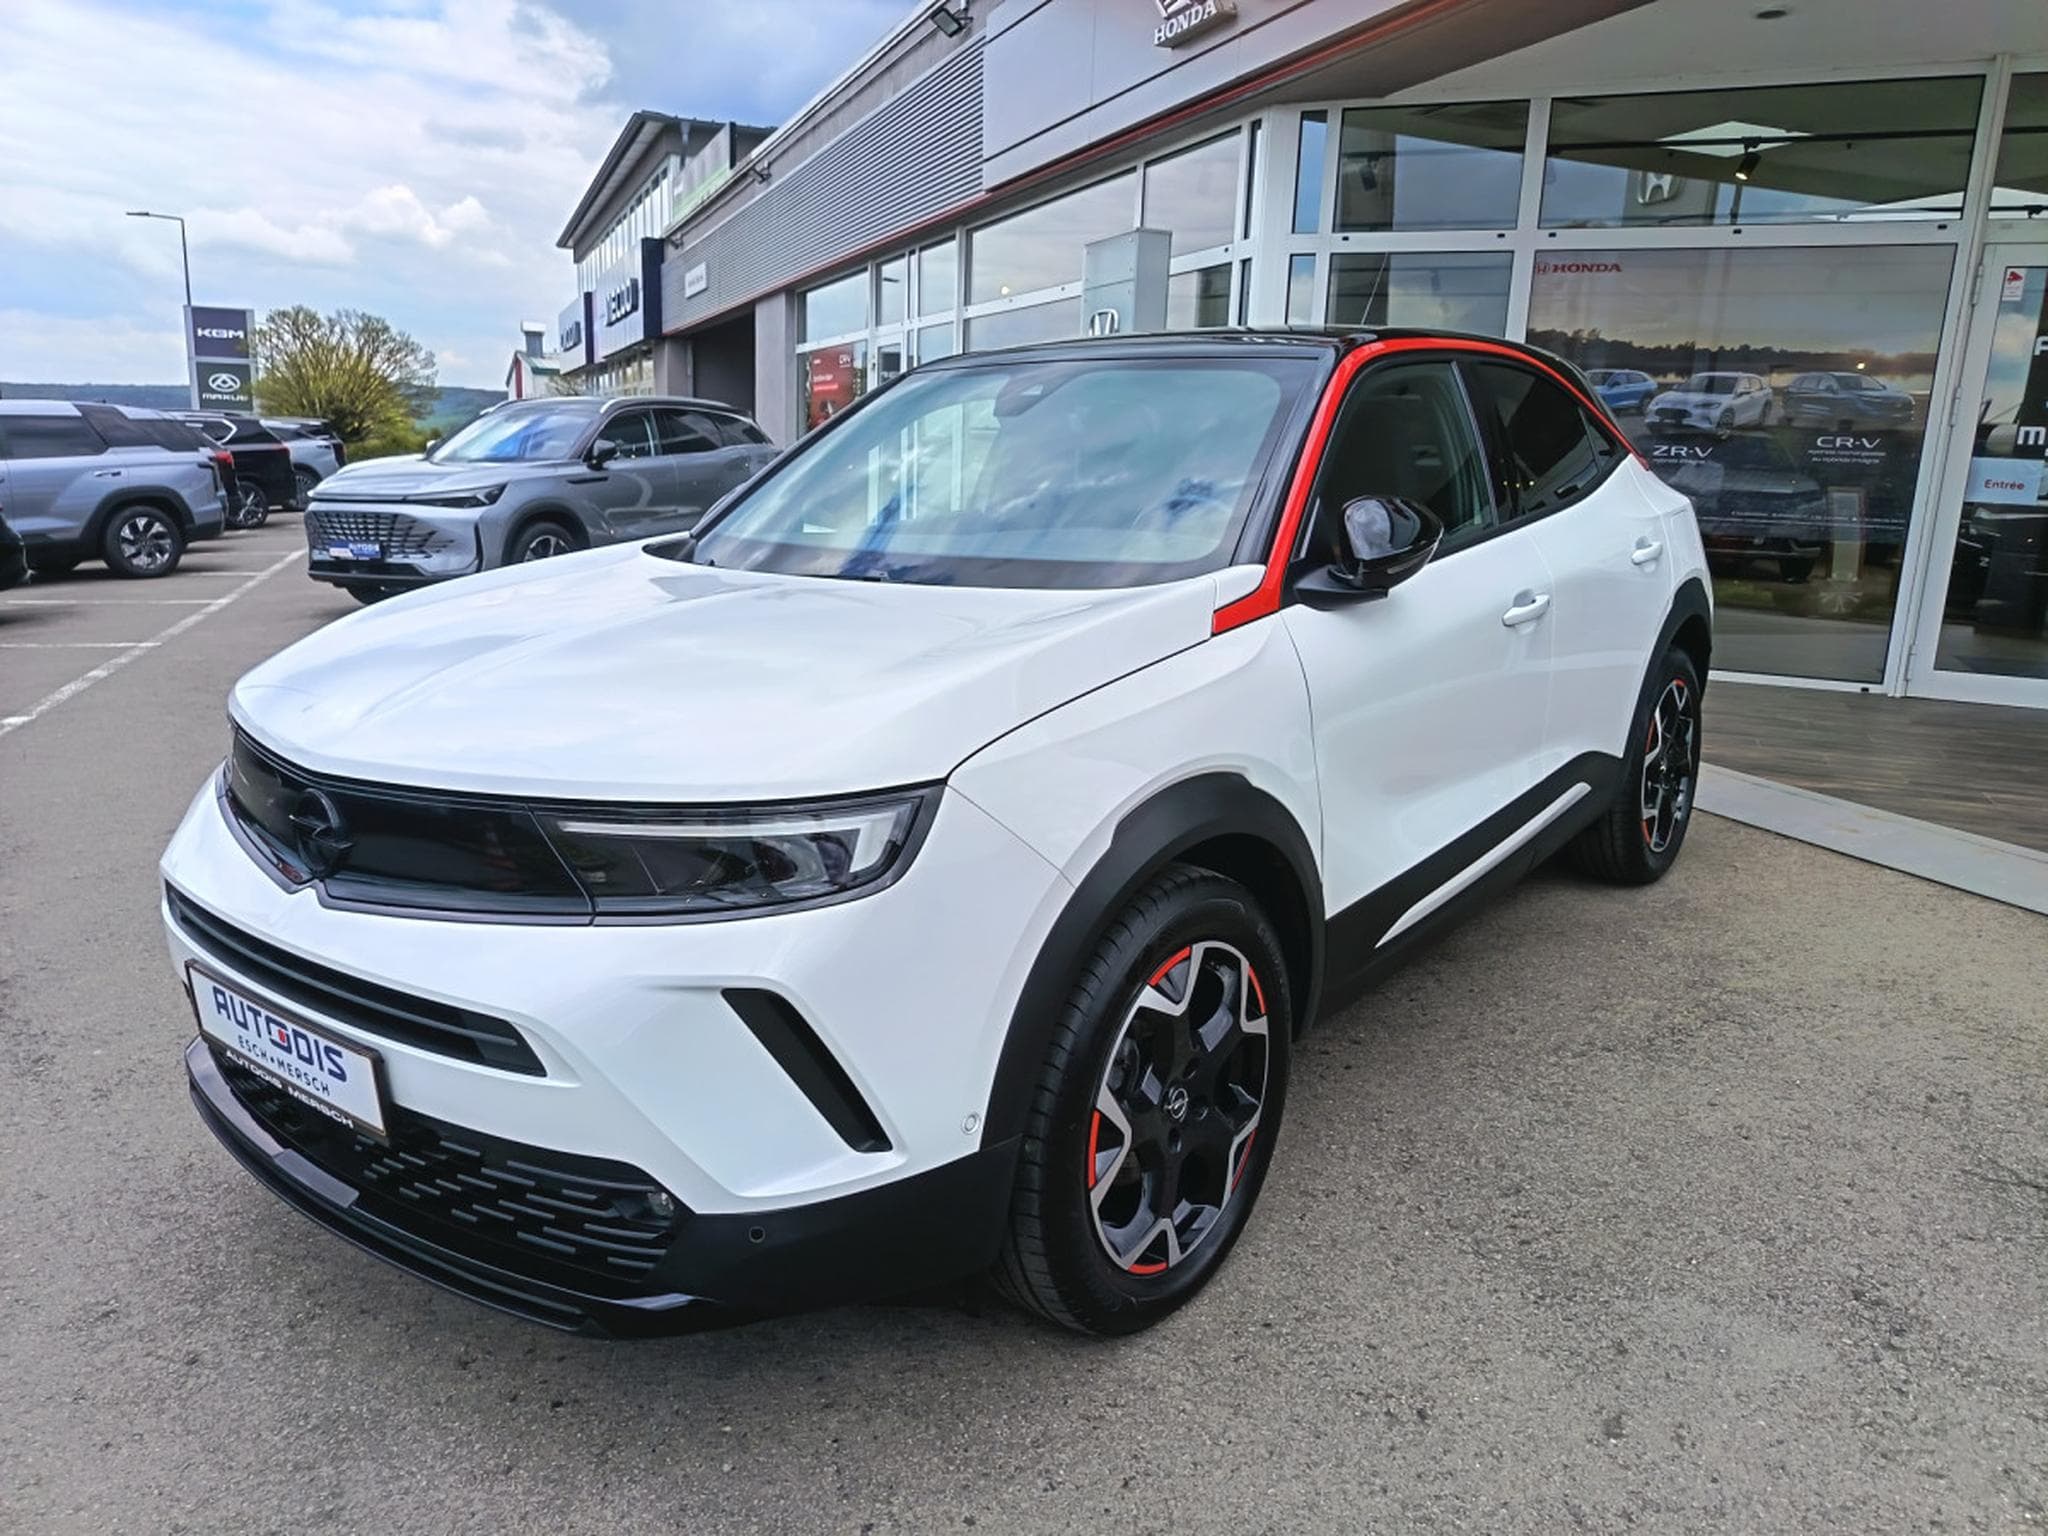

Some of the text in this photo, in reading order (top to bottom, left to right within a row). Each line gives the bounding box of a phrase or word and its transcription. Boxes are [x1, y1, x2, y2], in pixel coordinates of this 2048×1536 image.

[1154, 0, 1217, 45] HONDA
[1552, 262, 1622, 273] HONDA
[197, 328, 244, 339] KGM
[1816, 435, 1882, 449] CR-V
[1652, 444, 1713, 459] ZR-V
[1984, 479, 2026, 490] Entrée
[212, 986, 348, 1083] AUTODIS
[226, 1049, 355, 1130] AUTODIS MERSCH
